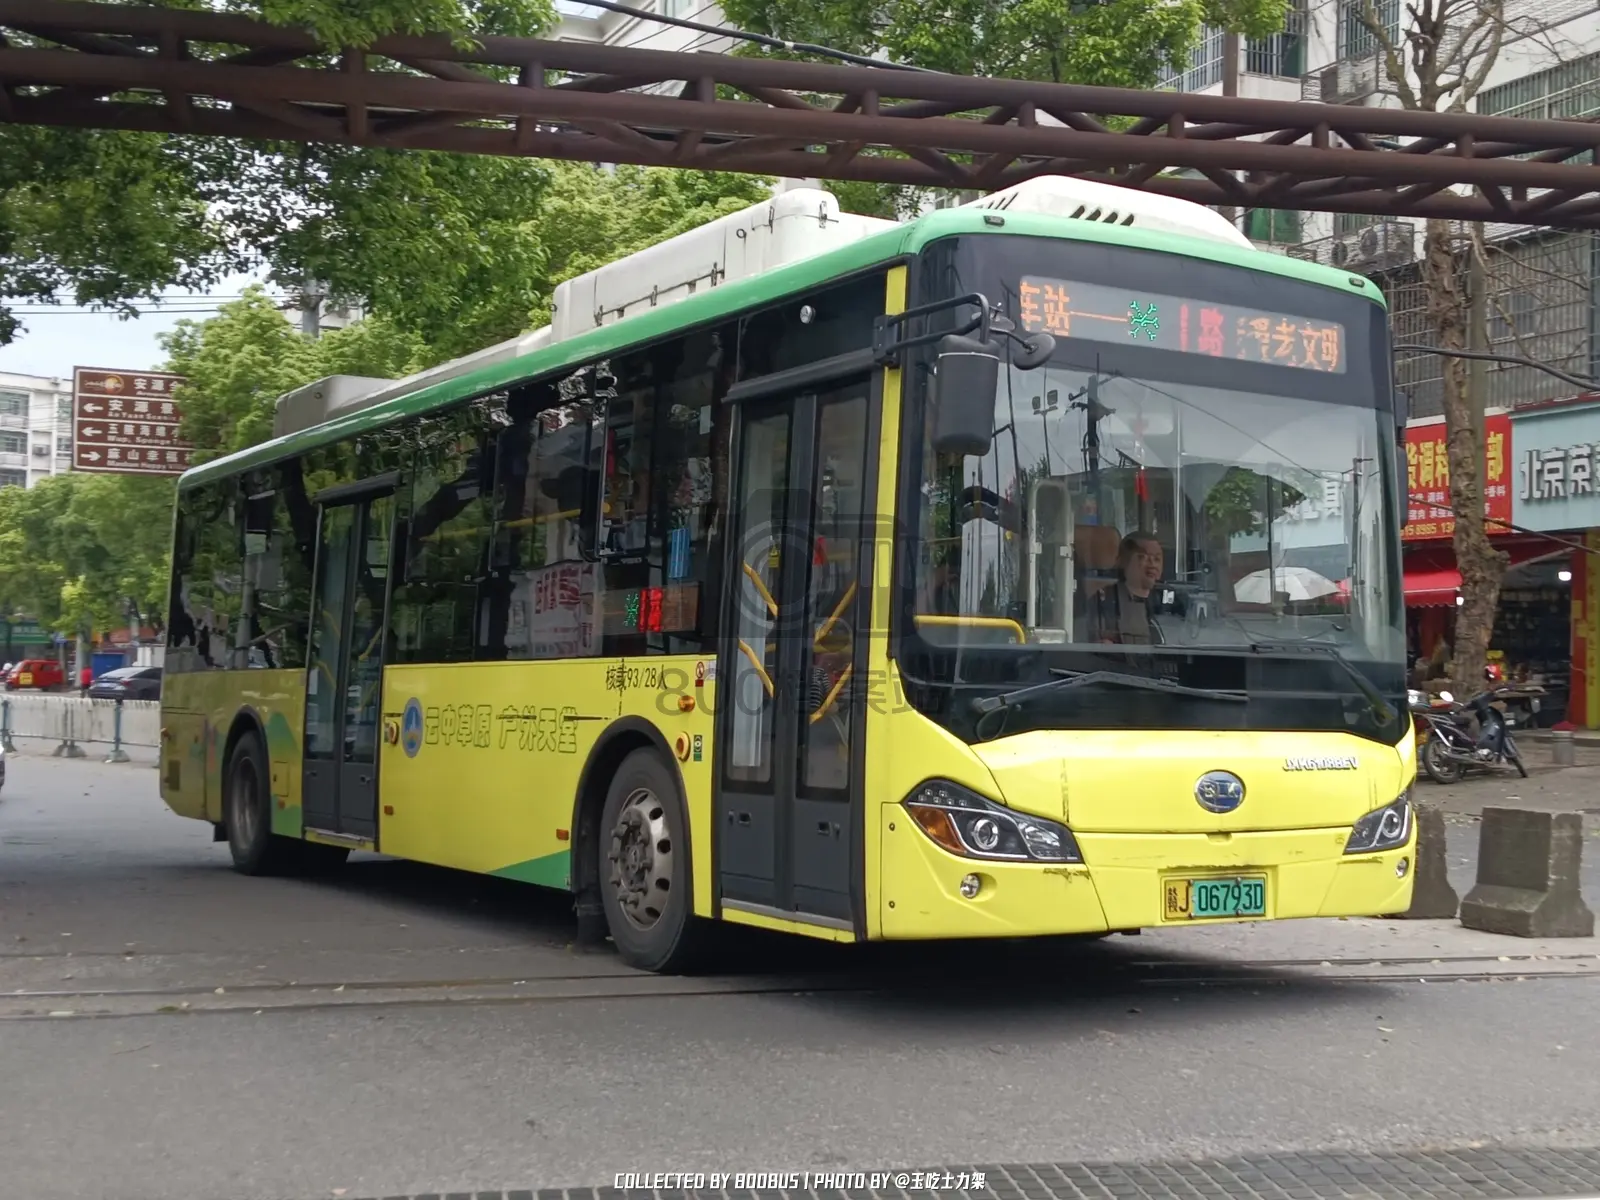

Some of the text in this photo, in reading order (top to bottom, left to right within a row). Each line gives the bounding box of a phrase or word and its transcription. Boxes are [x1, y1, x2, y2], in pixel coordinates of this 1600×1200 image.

[1519, 444, 1600, 500] 北京荣
[425, 704, 578, 753] 云中草原 户外天堂
